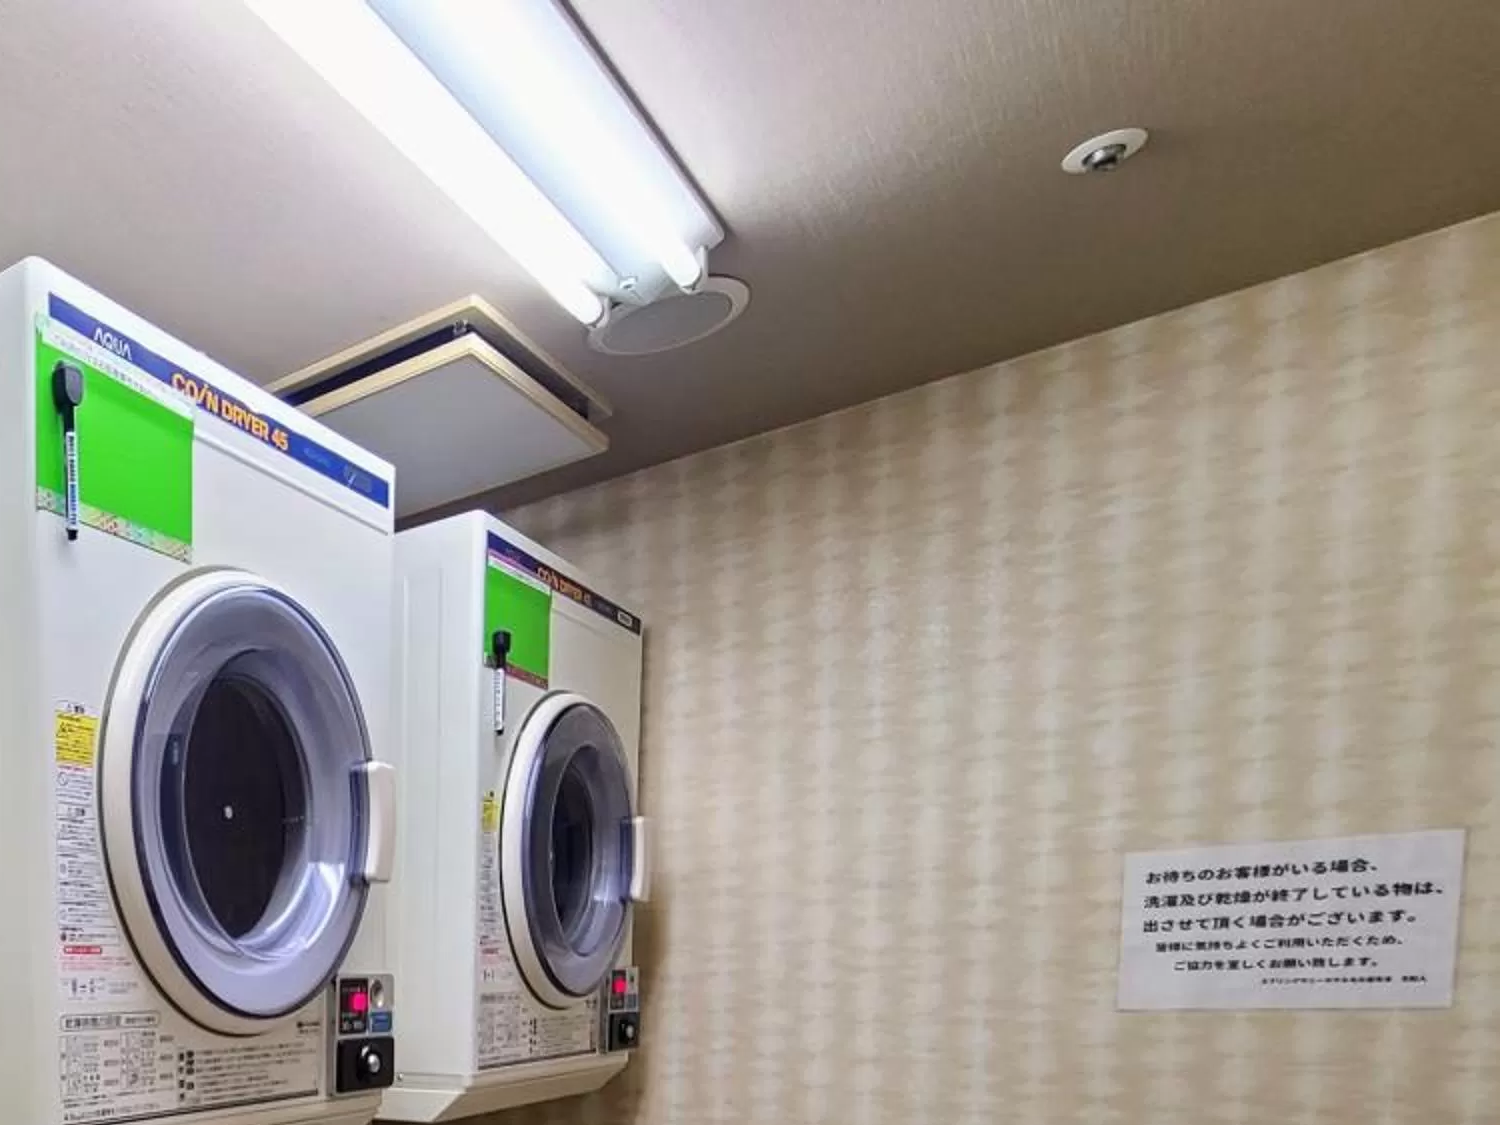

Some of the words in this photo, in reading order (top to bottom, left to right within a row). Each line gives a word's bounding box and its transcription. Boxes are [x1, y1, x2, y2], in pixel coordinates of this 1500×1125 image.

[93, 327, 132, 361] AQUA
[221, 398, 270, 441] DRYER
[1146, 858, 1378, 884] お待ちのお客様がいる場合、
[1143, 909, 1417, 932] 出させて頂く場合がございます。
